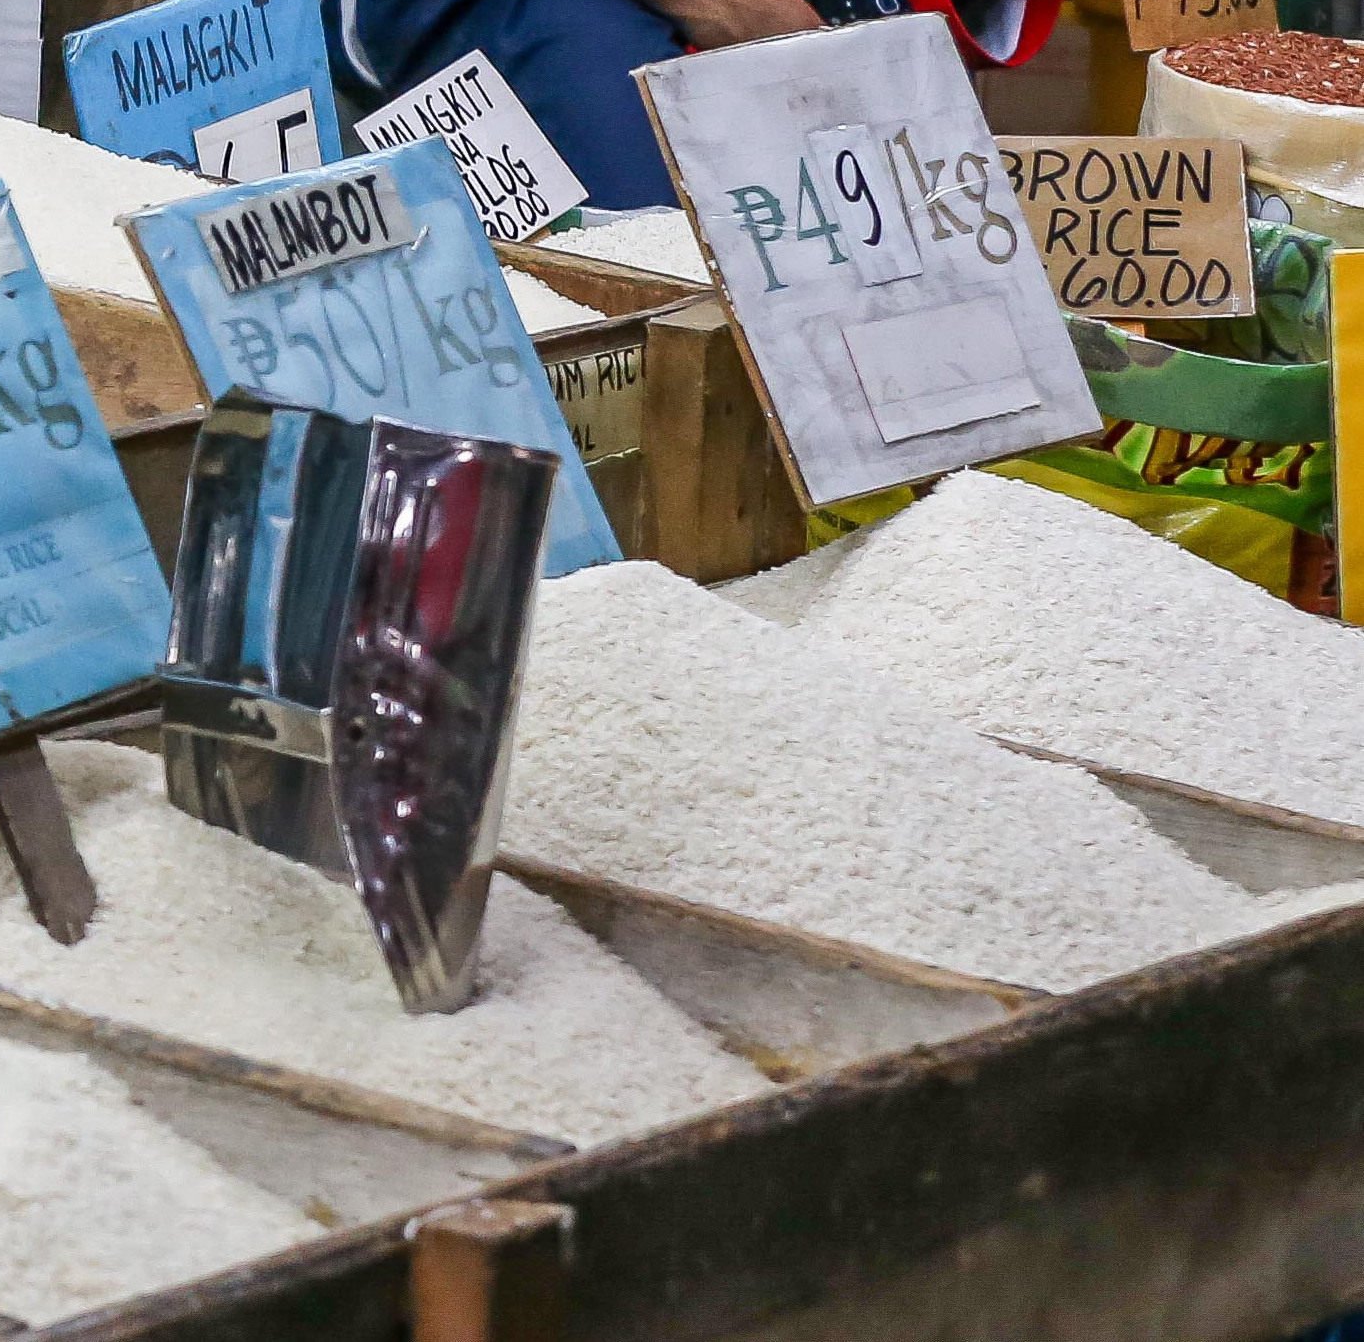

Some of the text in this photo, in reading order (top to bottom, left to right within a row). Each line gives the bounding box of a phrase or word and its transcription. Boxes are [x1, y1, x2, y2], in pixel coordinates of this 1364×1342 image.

[209, 173, 391, 289] MALAMBOT
[1044, 207, 1183, 258] RICE
[2, 530, 64, 580] RICE
